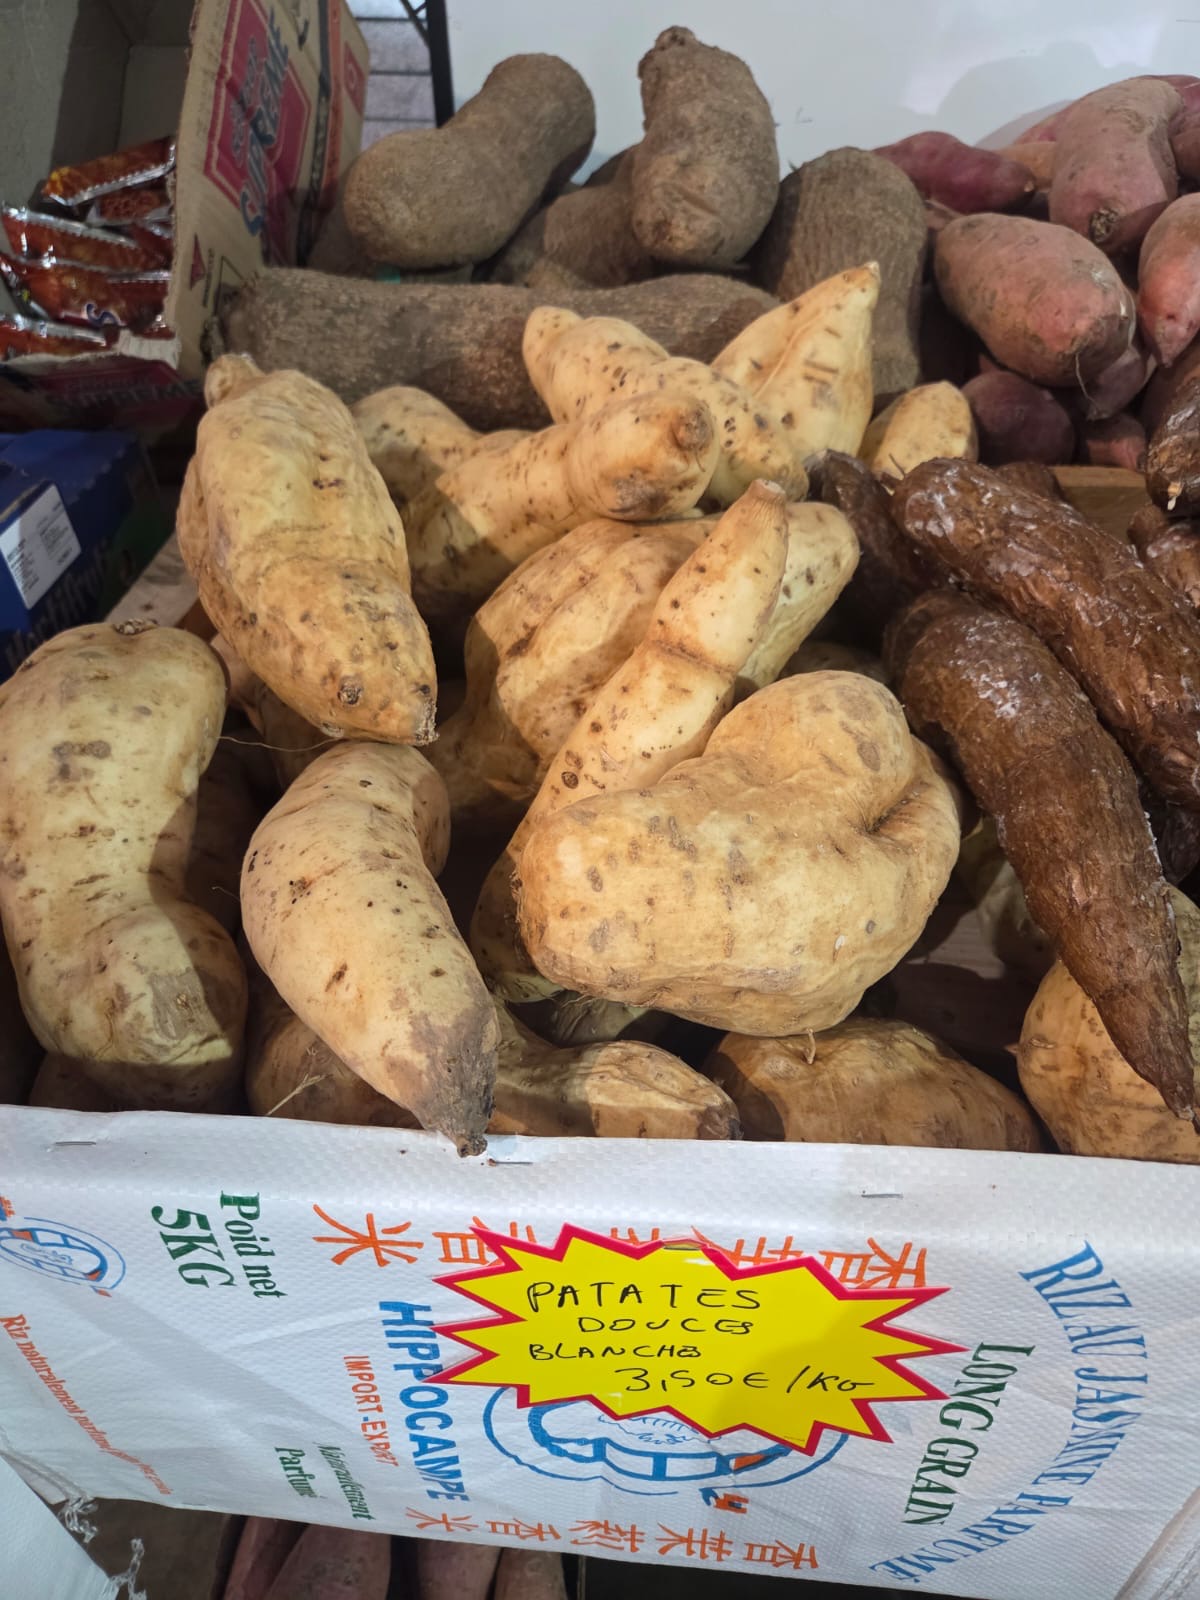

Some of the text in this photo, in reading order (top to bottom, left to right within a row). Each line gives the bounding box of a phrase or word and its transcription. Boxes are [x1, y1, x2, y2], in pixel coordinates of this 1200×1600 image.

[151, 1205, 238, 1288] 5KG
[220, 1190, 288, 1299] Poid net
[1018, 1240, 1133, 1319] RIZ
[527, 1281, 761, 1312] PATATES
[1063, 1325, 1149, 1360] AU
[378, 1301, 471, 1502] HIPPOCAMPE
[902, 1342, 1036, 1525] LONG GRAIN
[1032, 1367, 1149, 1486] JASMINE
